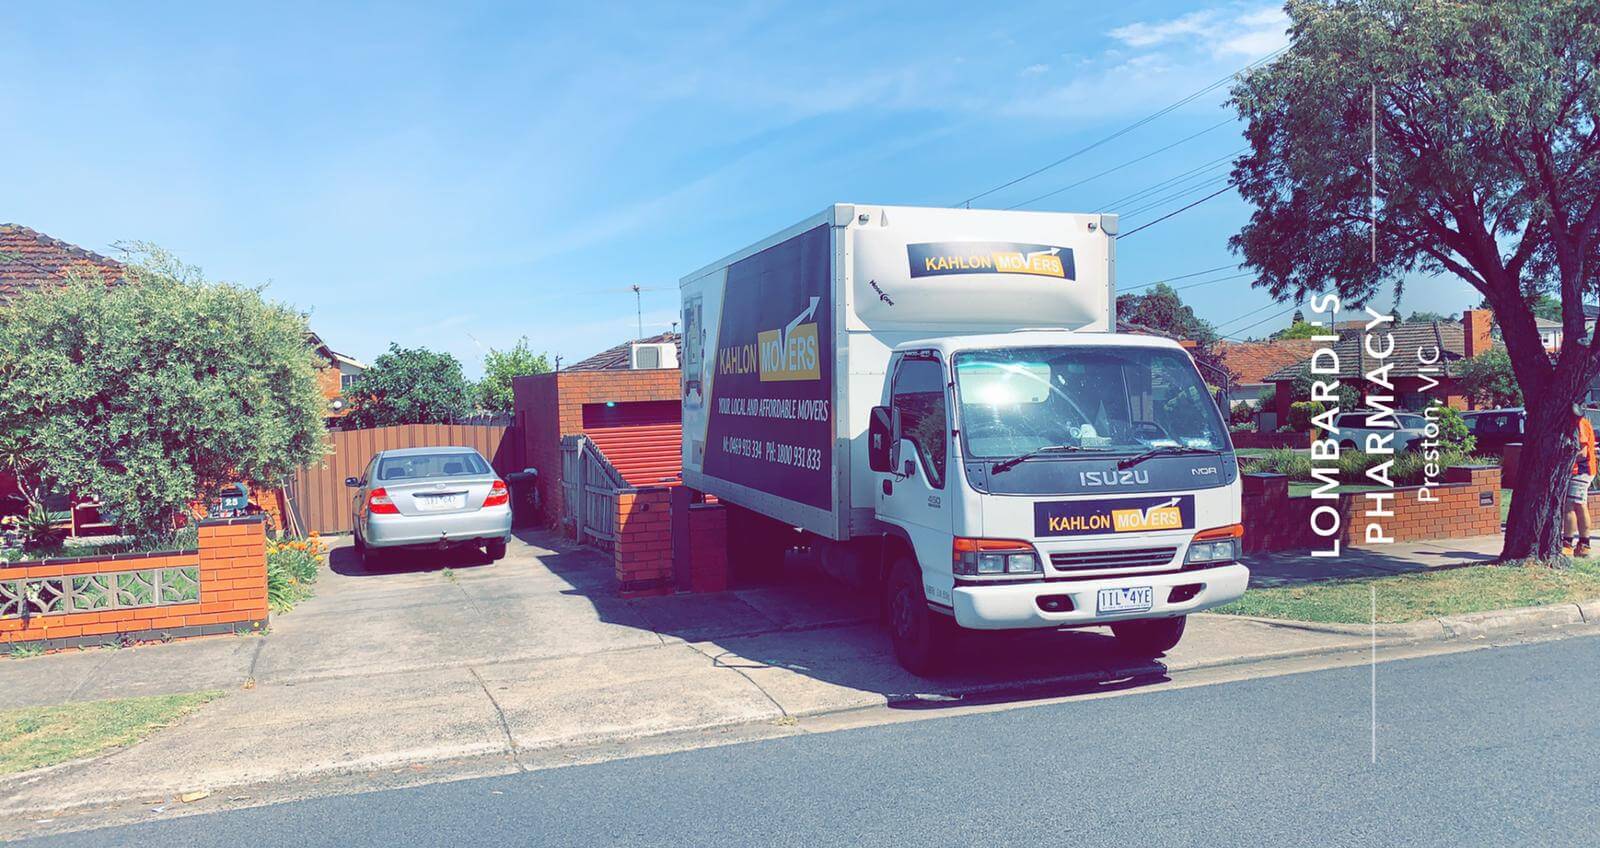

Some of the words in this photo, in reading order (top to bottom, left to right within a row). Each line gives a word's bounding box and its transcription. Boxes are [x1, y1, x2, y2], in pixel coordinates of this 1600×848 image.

[926, 256, 991, 271] KAHLON
[999, 252, 1060, 273] MOVERS
[719, 343, 757, 375] KAHLON
[761, 328, 817, 373] MOVERS
[718, 397, 731, 415] YOUR
[731, 398, 746, 416] LOCAL
[746, 398, 759, 416] AND
[759, 398, 797, 419] AFFORDABLE
[797, 399, 829, 421] MOVERS
[793, 446, 806, 468] 931
[806, 448, 821, 471] 833
[1079, 470, 1149, 487] ISUZU
[1049, 515, 1111, 532] KAHLON
[1117, 508, 1179, 528] MOVERS
[1130, 590, 1151, 604] 4YE
